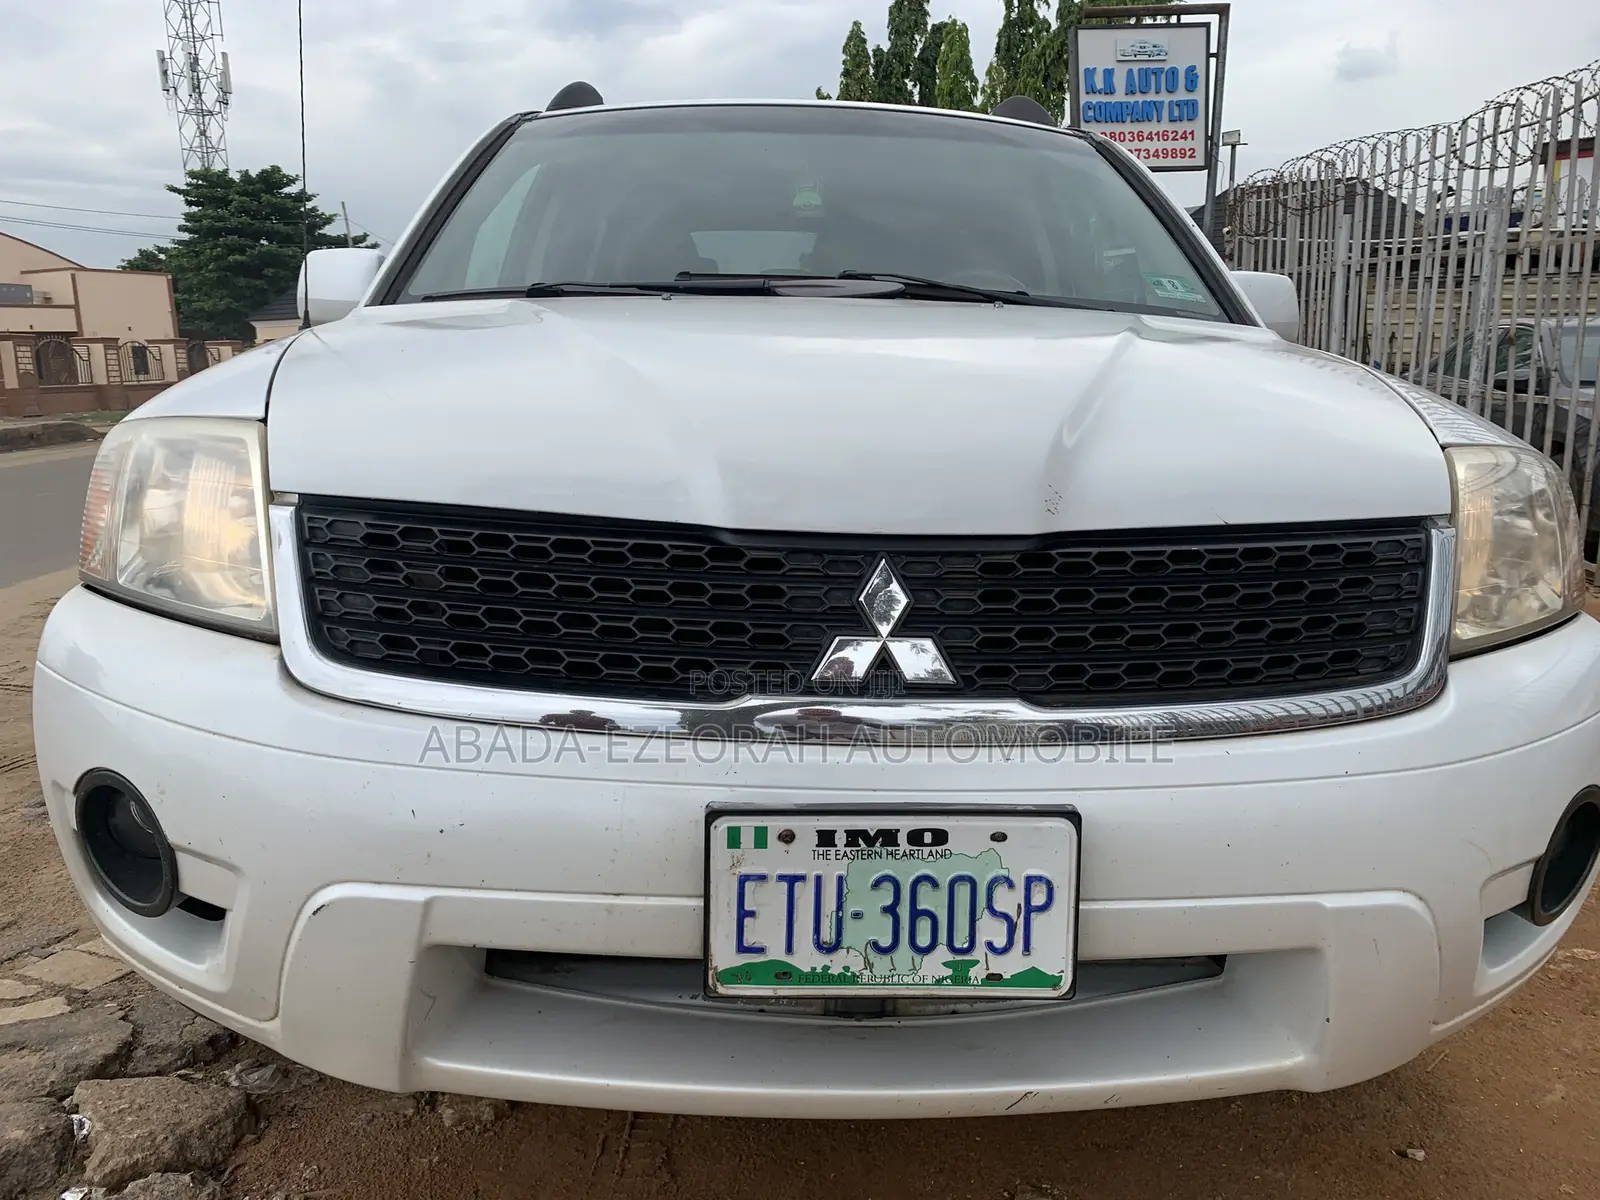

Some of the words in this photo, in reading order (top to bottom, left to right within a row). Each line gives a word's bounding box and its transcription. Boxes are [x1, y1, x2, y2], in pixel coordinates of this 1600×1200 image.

[1083, 67, 1116, 95] K.K
[1125, 66, 1180, 95] AUTO
[1184, 65, 1200, 92] &
[1082, 100, 1165, 123] COMPANY
[1168, 99, 1199, 122] LTD
[1127, 147, 1196, 160] 7349892
[815, 828, 949, 848] IMO
[812, 849, 832, 861] THE
[835, 849, 883, 861] EASTERN
[886, 849, 953, 861] HEARTLAND
[735, 873, 1055, 956] ETU-360SP
[798, 974, 849, 984] FEDERAL
[852, 974, 910, 984] REPUBLIC
[912, 974, 929, 984] OF
[931, 974, 980, 985] NIGERIA
